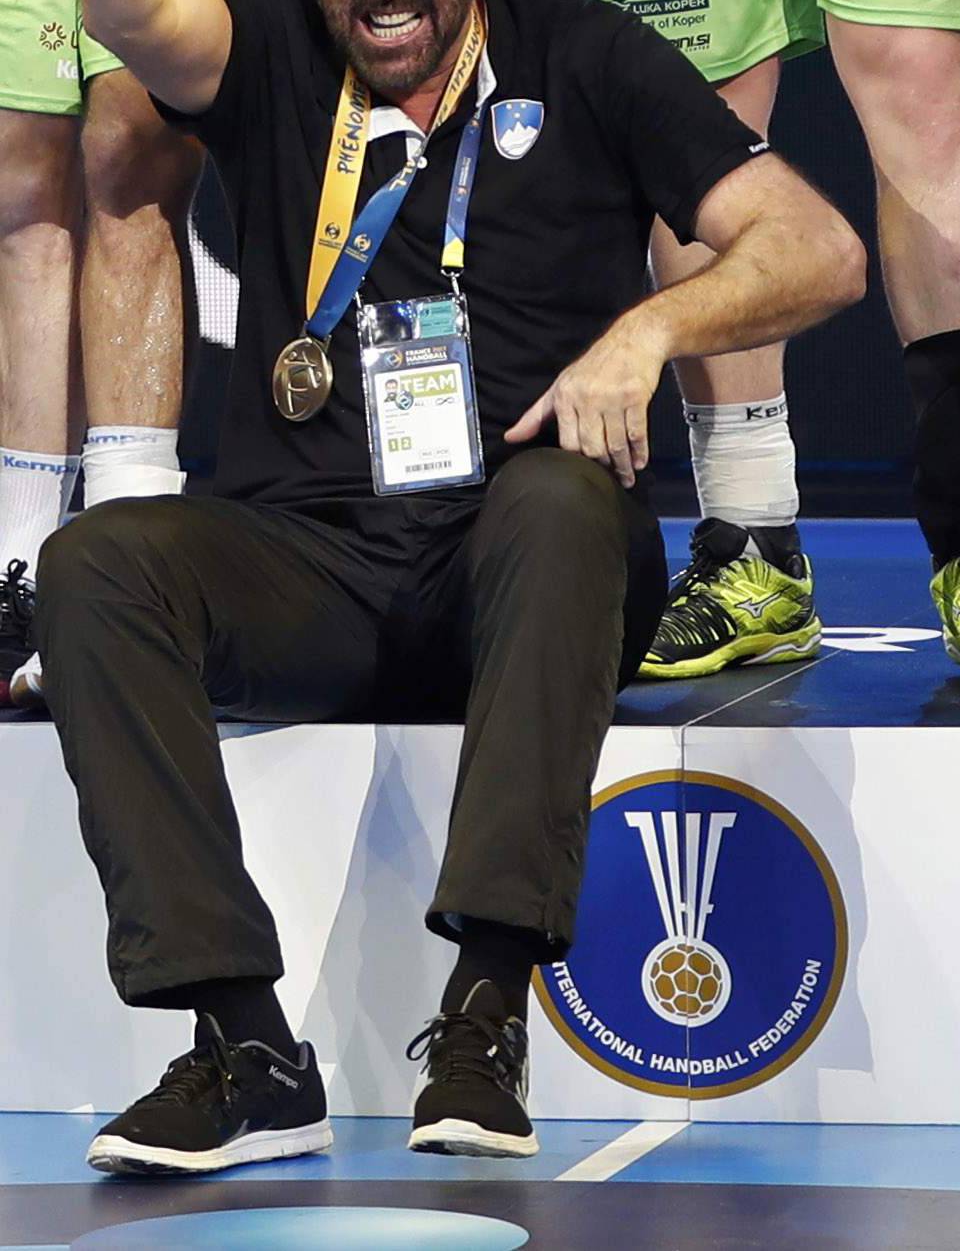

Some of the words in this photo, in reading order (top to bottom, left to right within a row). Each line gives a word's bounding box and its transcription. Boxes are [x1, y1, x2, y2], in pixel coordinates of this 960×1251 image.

[633, 2, 661, 14] LUKA
[658, 17, 670, 29] of
[672, 14, 706, 28] Koper
[401, 373, 456, 394] TEAM
[88, 434, 158, 446] mpa
[551, 960, 645, 1066] TERNATIONAL
[649, 1050, 749, 1076] HANDBALL
[748, 958, 822, 1059] FEDERATION
